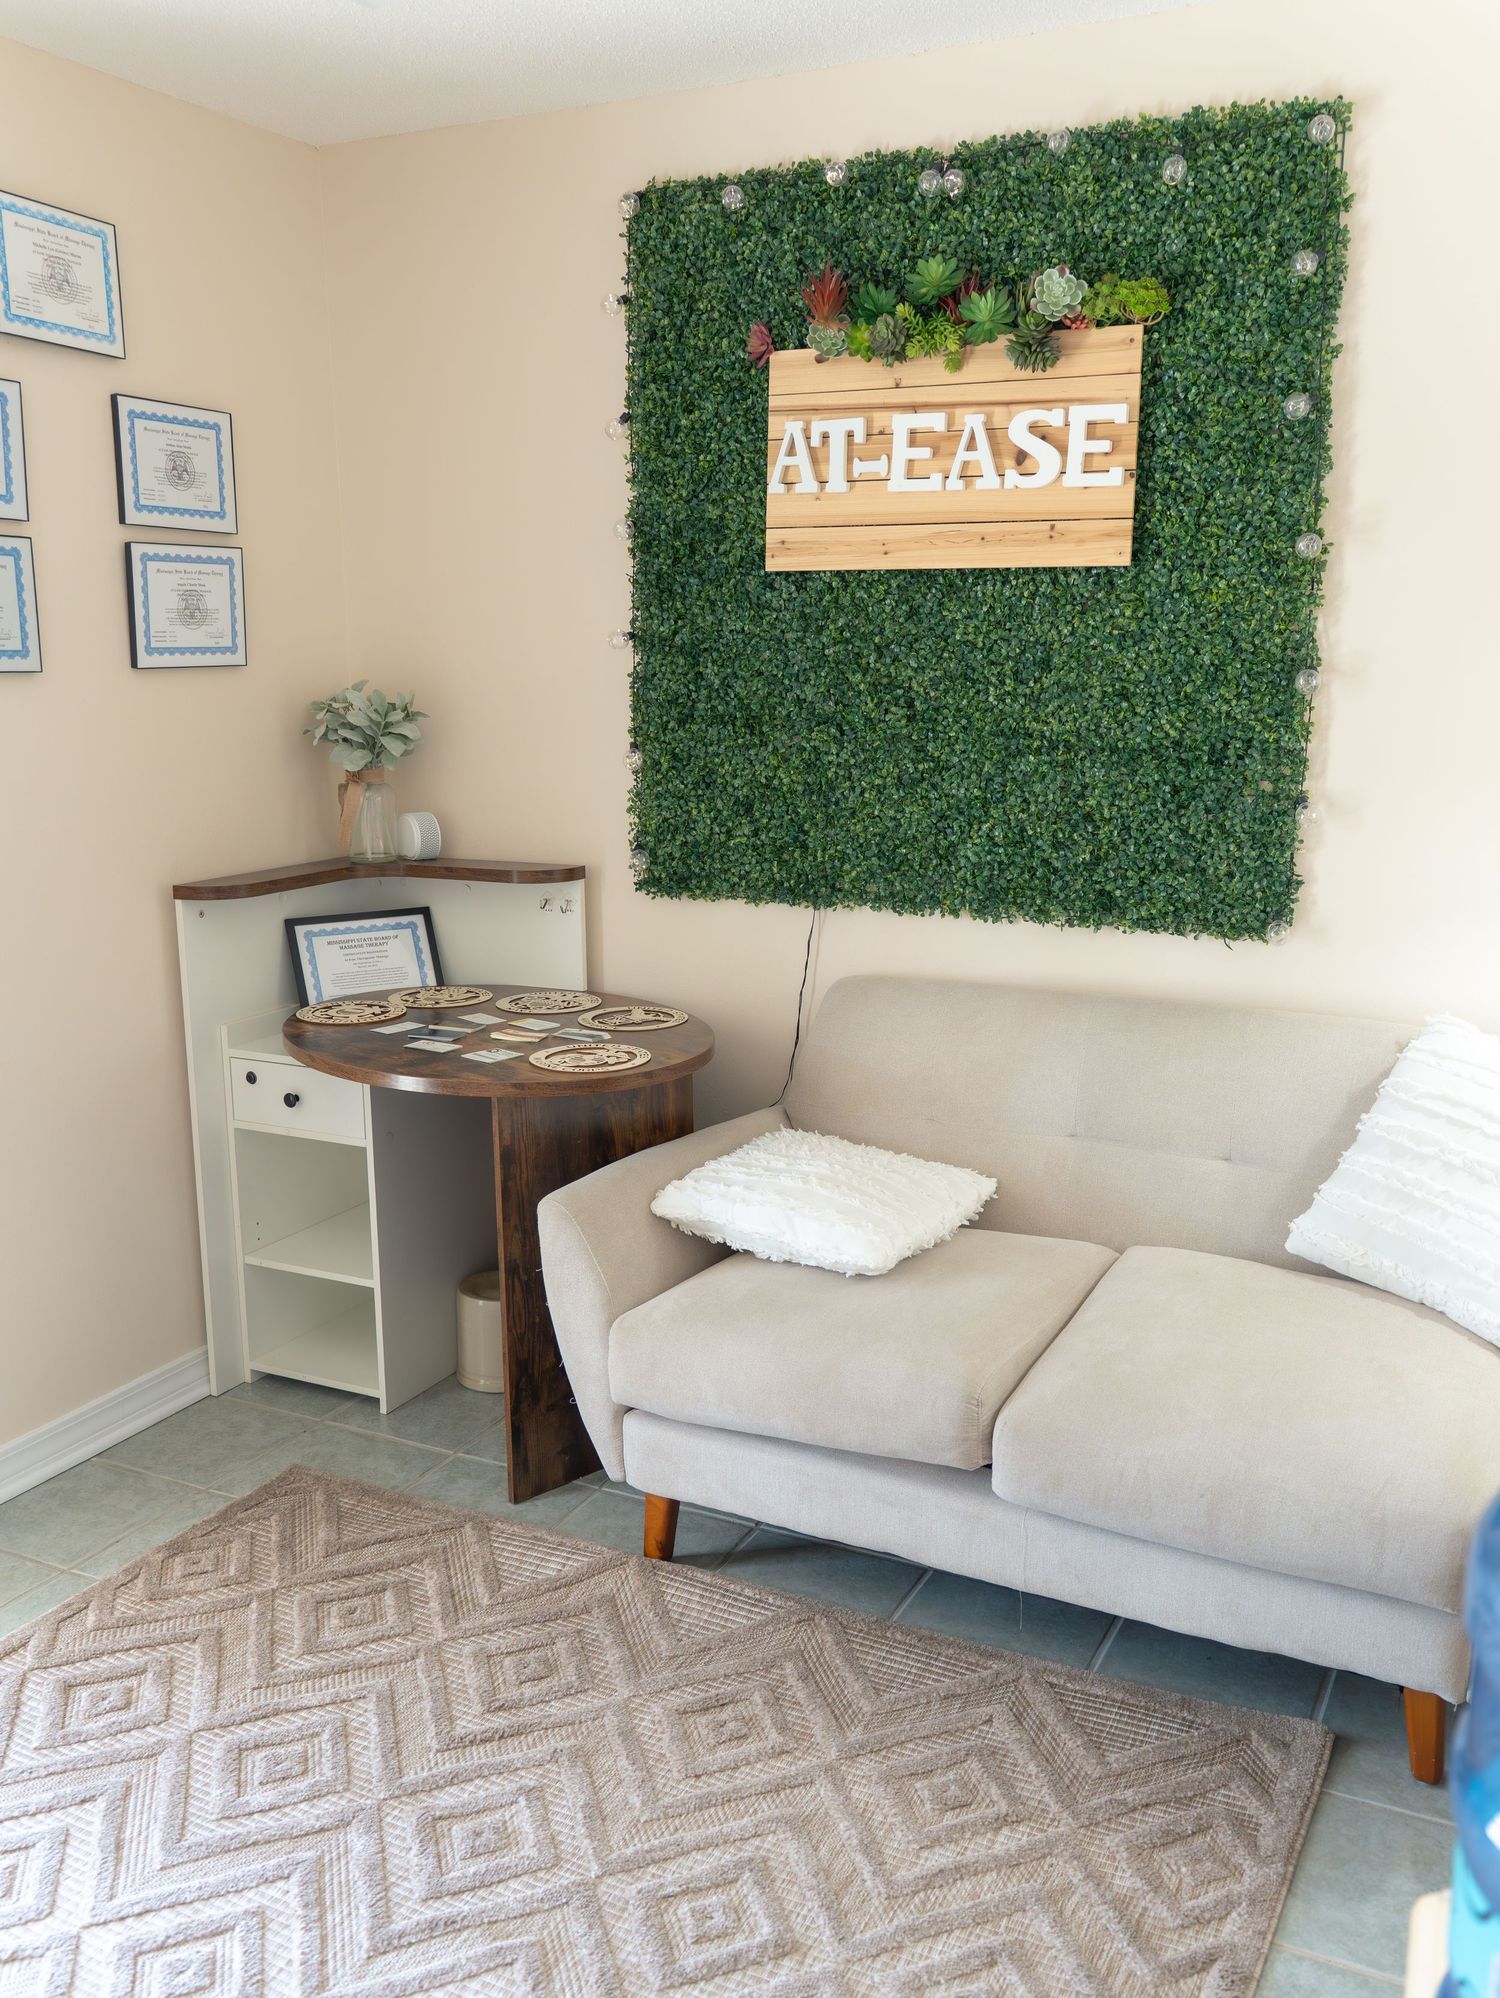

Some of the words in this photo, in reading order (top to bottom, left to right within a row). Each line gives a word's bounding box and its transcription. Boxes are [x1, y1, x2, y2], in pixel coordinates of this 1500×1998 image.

[768, 403, 1130, 494] AT-EASE
[326, 937, 356, 946] MISSISSIPPI
[339, 942, 365, 950] MASSAGE
[365, 940, 389, 948] THERAPY
